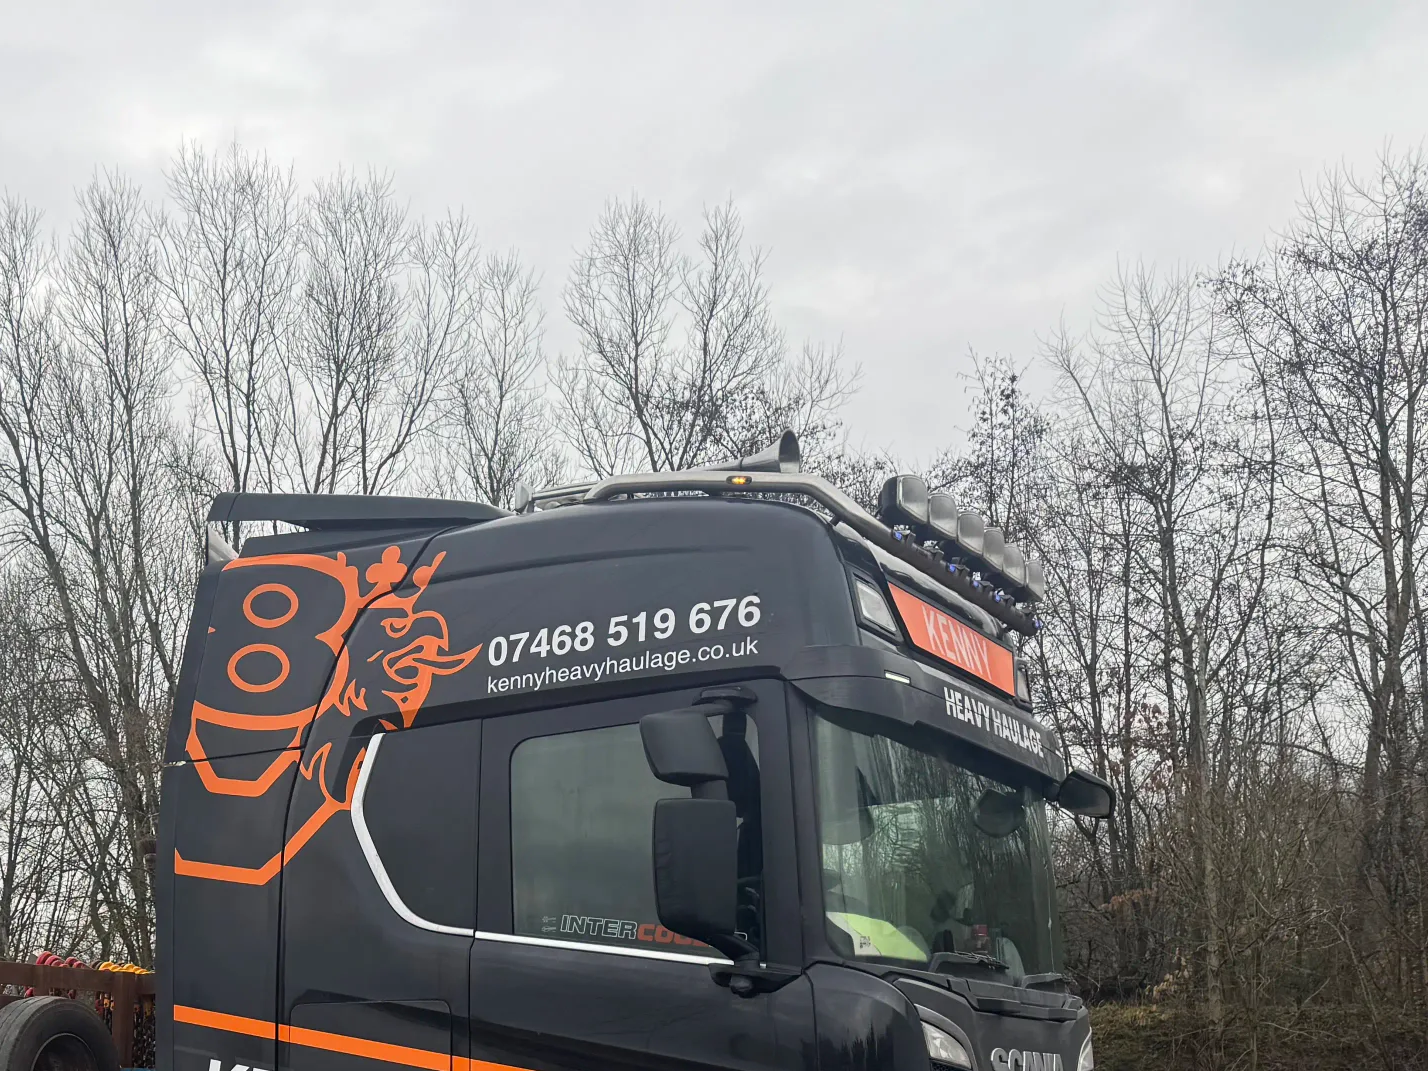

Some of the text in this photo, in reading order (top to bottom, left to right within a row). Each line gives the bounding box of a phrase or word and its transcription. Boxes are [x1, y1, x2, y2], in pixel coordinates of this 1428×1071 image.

[487, 636, 759, 693] kennyheavyhaulage.co.uk
[488, 595, 762, 667] 07468 519 676
[922, 605, 992, 681] KENNY
[943, 687, 1045, 758] HEAVY HAULAGE
